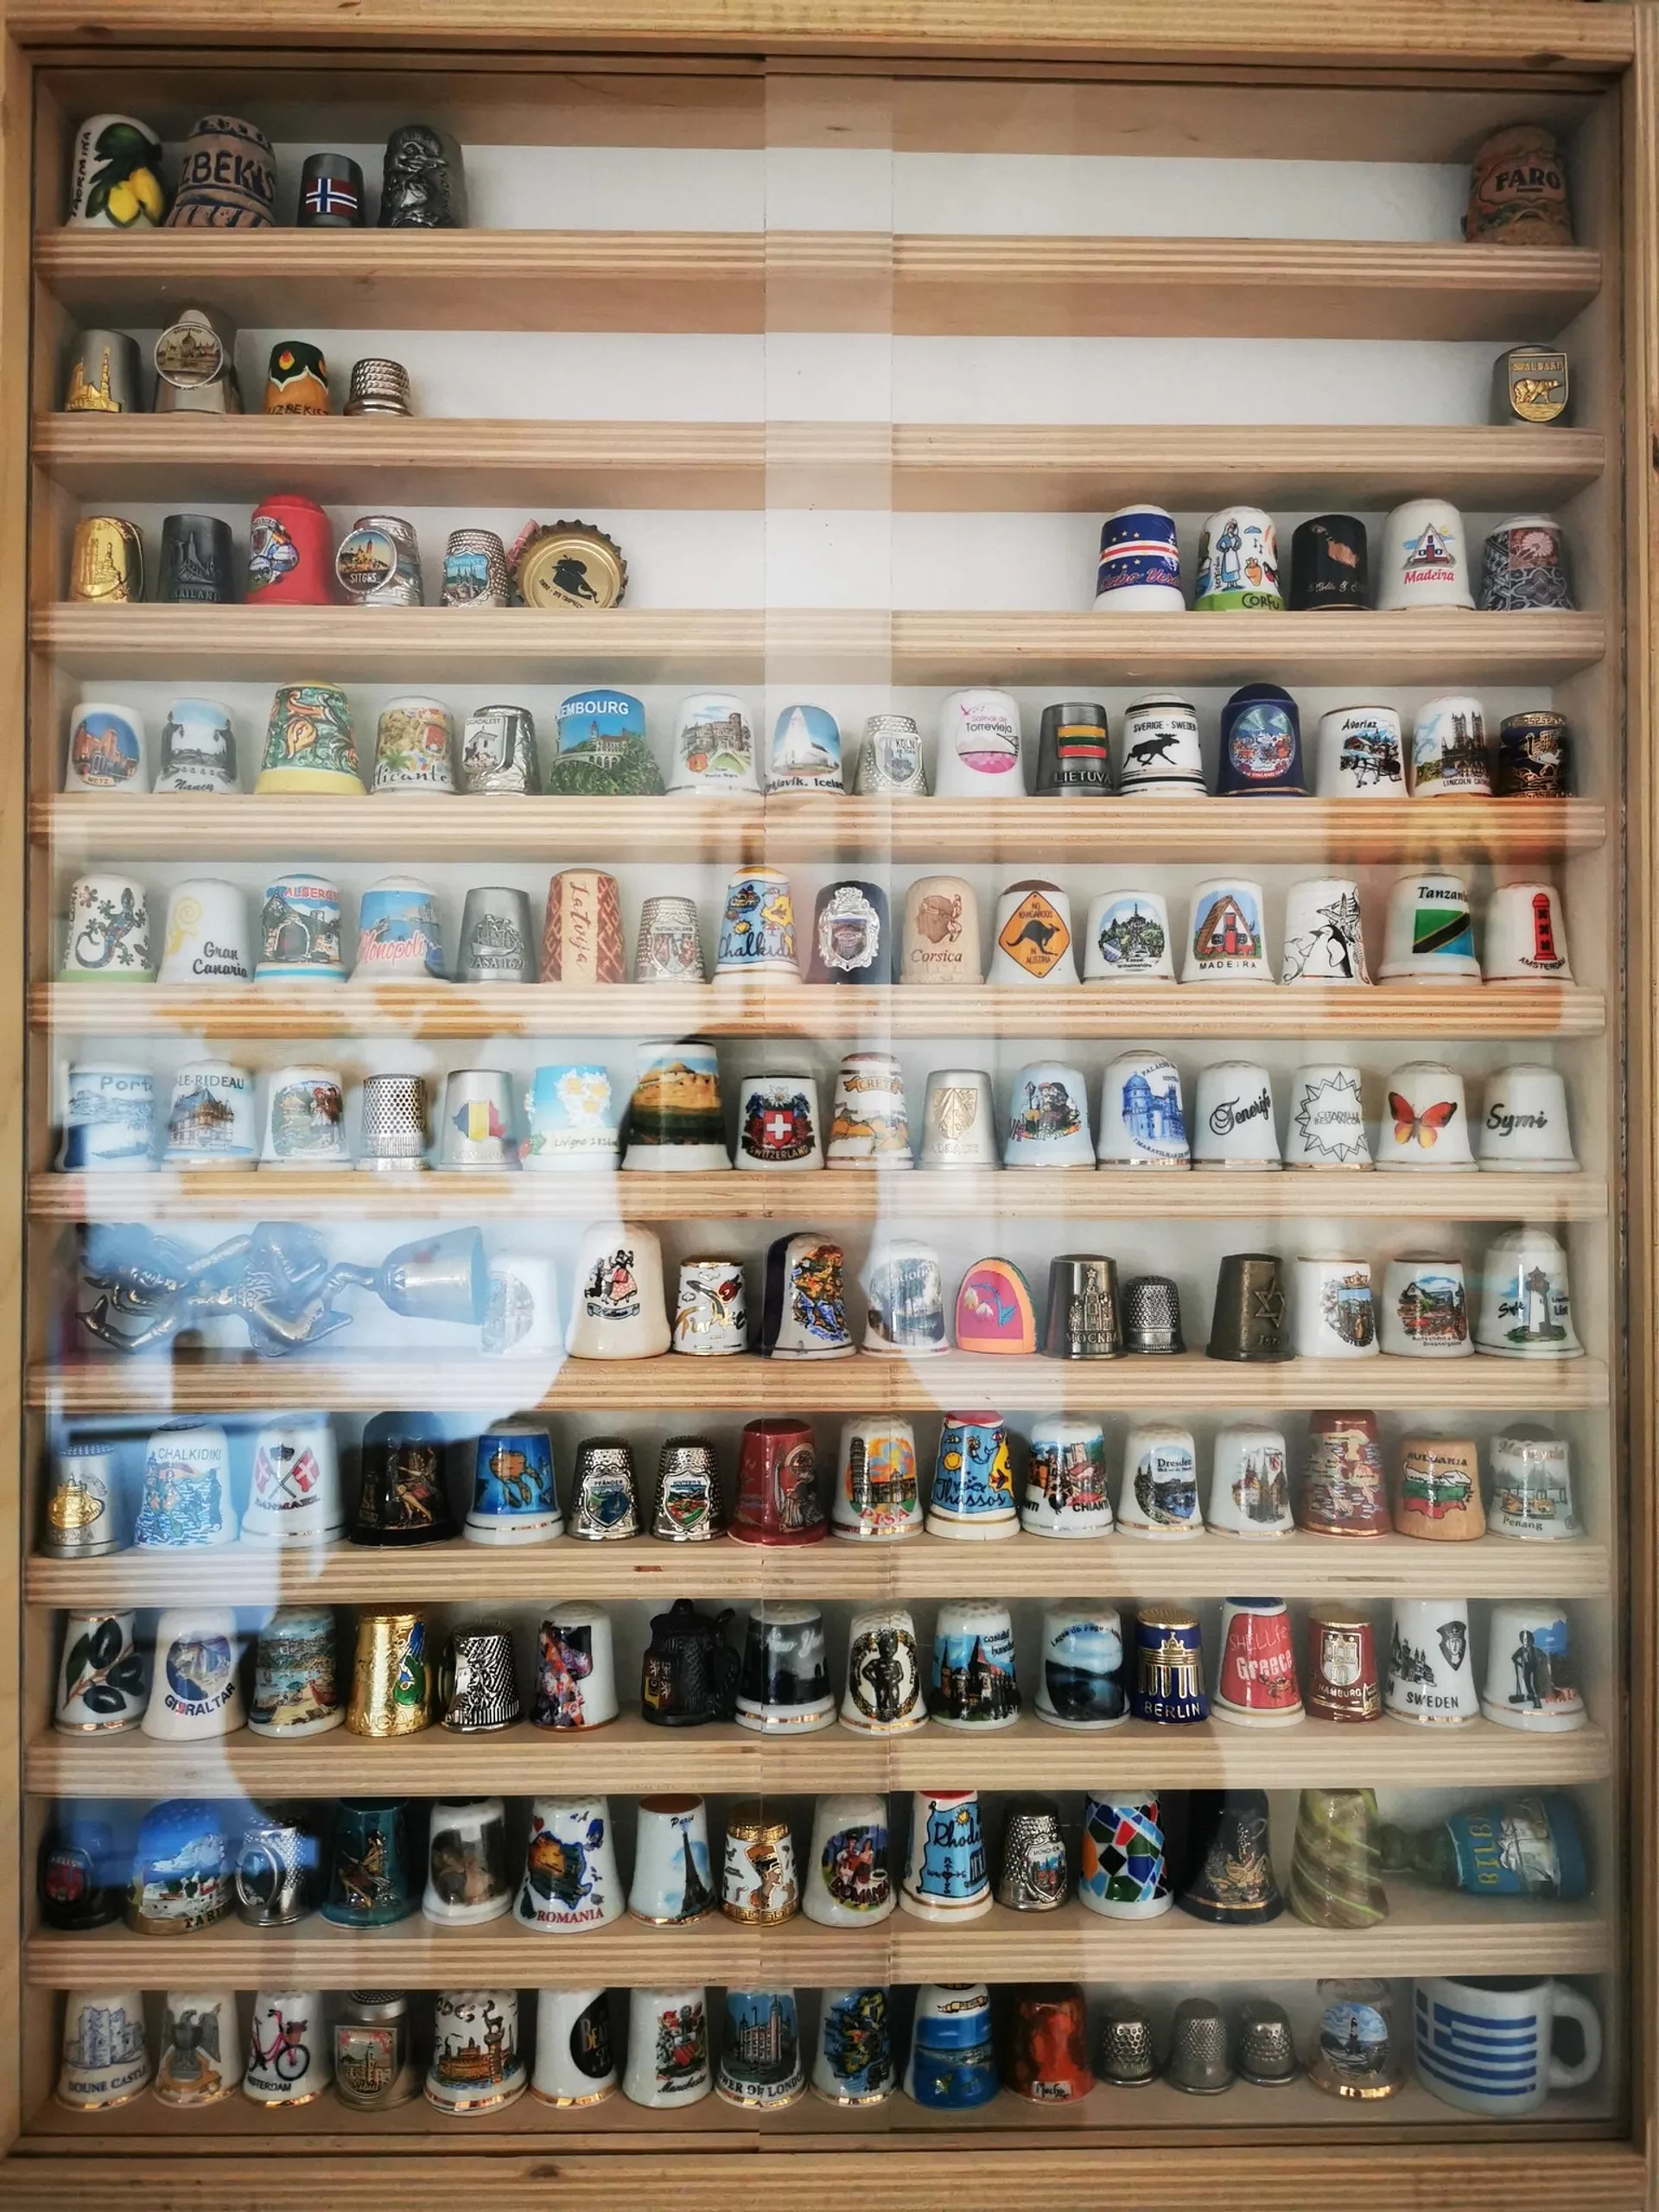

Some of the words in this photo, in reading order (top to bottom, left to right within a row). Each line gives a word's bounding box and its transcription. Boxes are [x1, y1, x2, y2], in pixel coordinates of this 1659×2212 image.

[1495, 168, 1560, 192] FARO
[349, 572, 378, 583] SITGES
[1403, 569, 1455, 584] Madeira
[1242, 593, 1280, 610] CORFU
[966, 721, 1013, 734] Torrevieja
[1134, 721, 1164, 732] SVERIGE
[1171, 721, 1197, 732] SWEDEN
[175, 779, 214, 792] Nancy
[1443, 779, 1471, 787] LINCOLN
[1019, 910, 1053, 919] KANGAROOS
[569, 880, 594, 971] Latvija
[203, 943, 238, 960] Gran
[359, 929, 427, 966] Monopoli
[910, 948, 963, 963] Corsica
[1026, 956, 1052, 964] AUSTRIA
[193, 957, 248, 978] Canaria
[1518, 957, 1566, 970] AMSTERDAM
[859, 1078, 896, 1092] CRETE
[1486, 1103, 1548, 1137] Symi
[555, 1138, 588, 1149] Livigno
[749, 1146, 810, 1160] SWITZERLAND
[158, 1447, 221, 1461] CHALKIDIKI
[1157, 1457, 1192, 1468] Dresden
[936, 1477, 1007, 1507] Thassos
[860, 1506, 910, 1525] PISA
[1503, 1516, 1543, 1531] Penang
[1236, 1649, 1294, 1681] Greece
[1318, 1684, 1362, 1698] HAMBURG
[164, 1682, 236, 1716] GIBRALTAR
[1406, 1691, 1459, 1708] SWEDEN
[1145, 1700, 1200, 1719] BERLIN
[536, 1907, 605, 1925] ROMANIA
